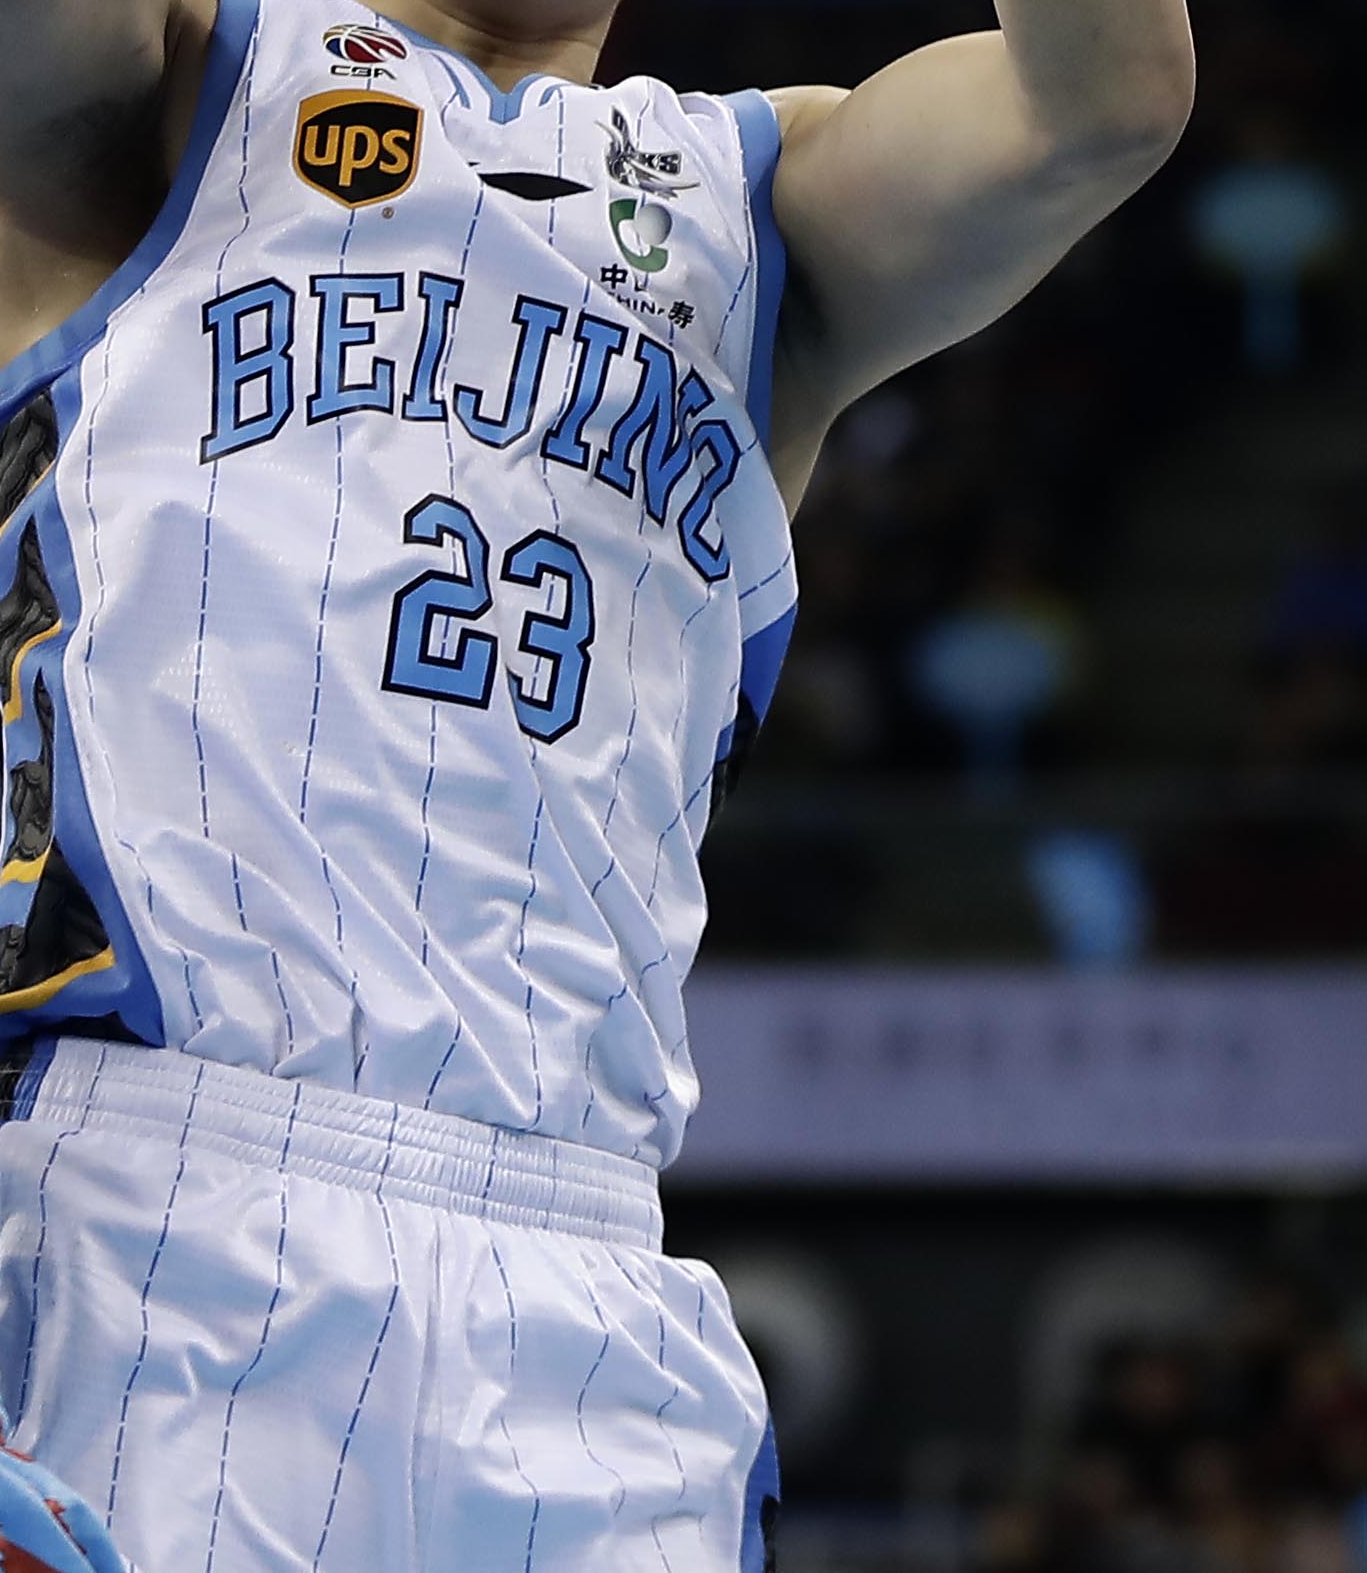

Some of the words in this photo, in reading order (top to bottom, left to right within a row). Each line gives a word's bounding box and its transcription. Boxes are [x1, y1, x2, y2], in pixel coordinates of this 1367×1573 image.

[330, 64, 397, 80] CBA
[303, 125, 411, 187] ups
[381, 493, 596, 743] 23
